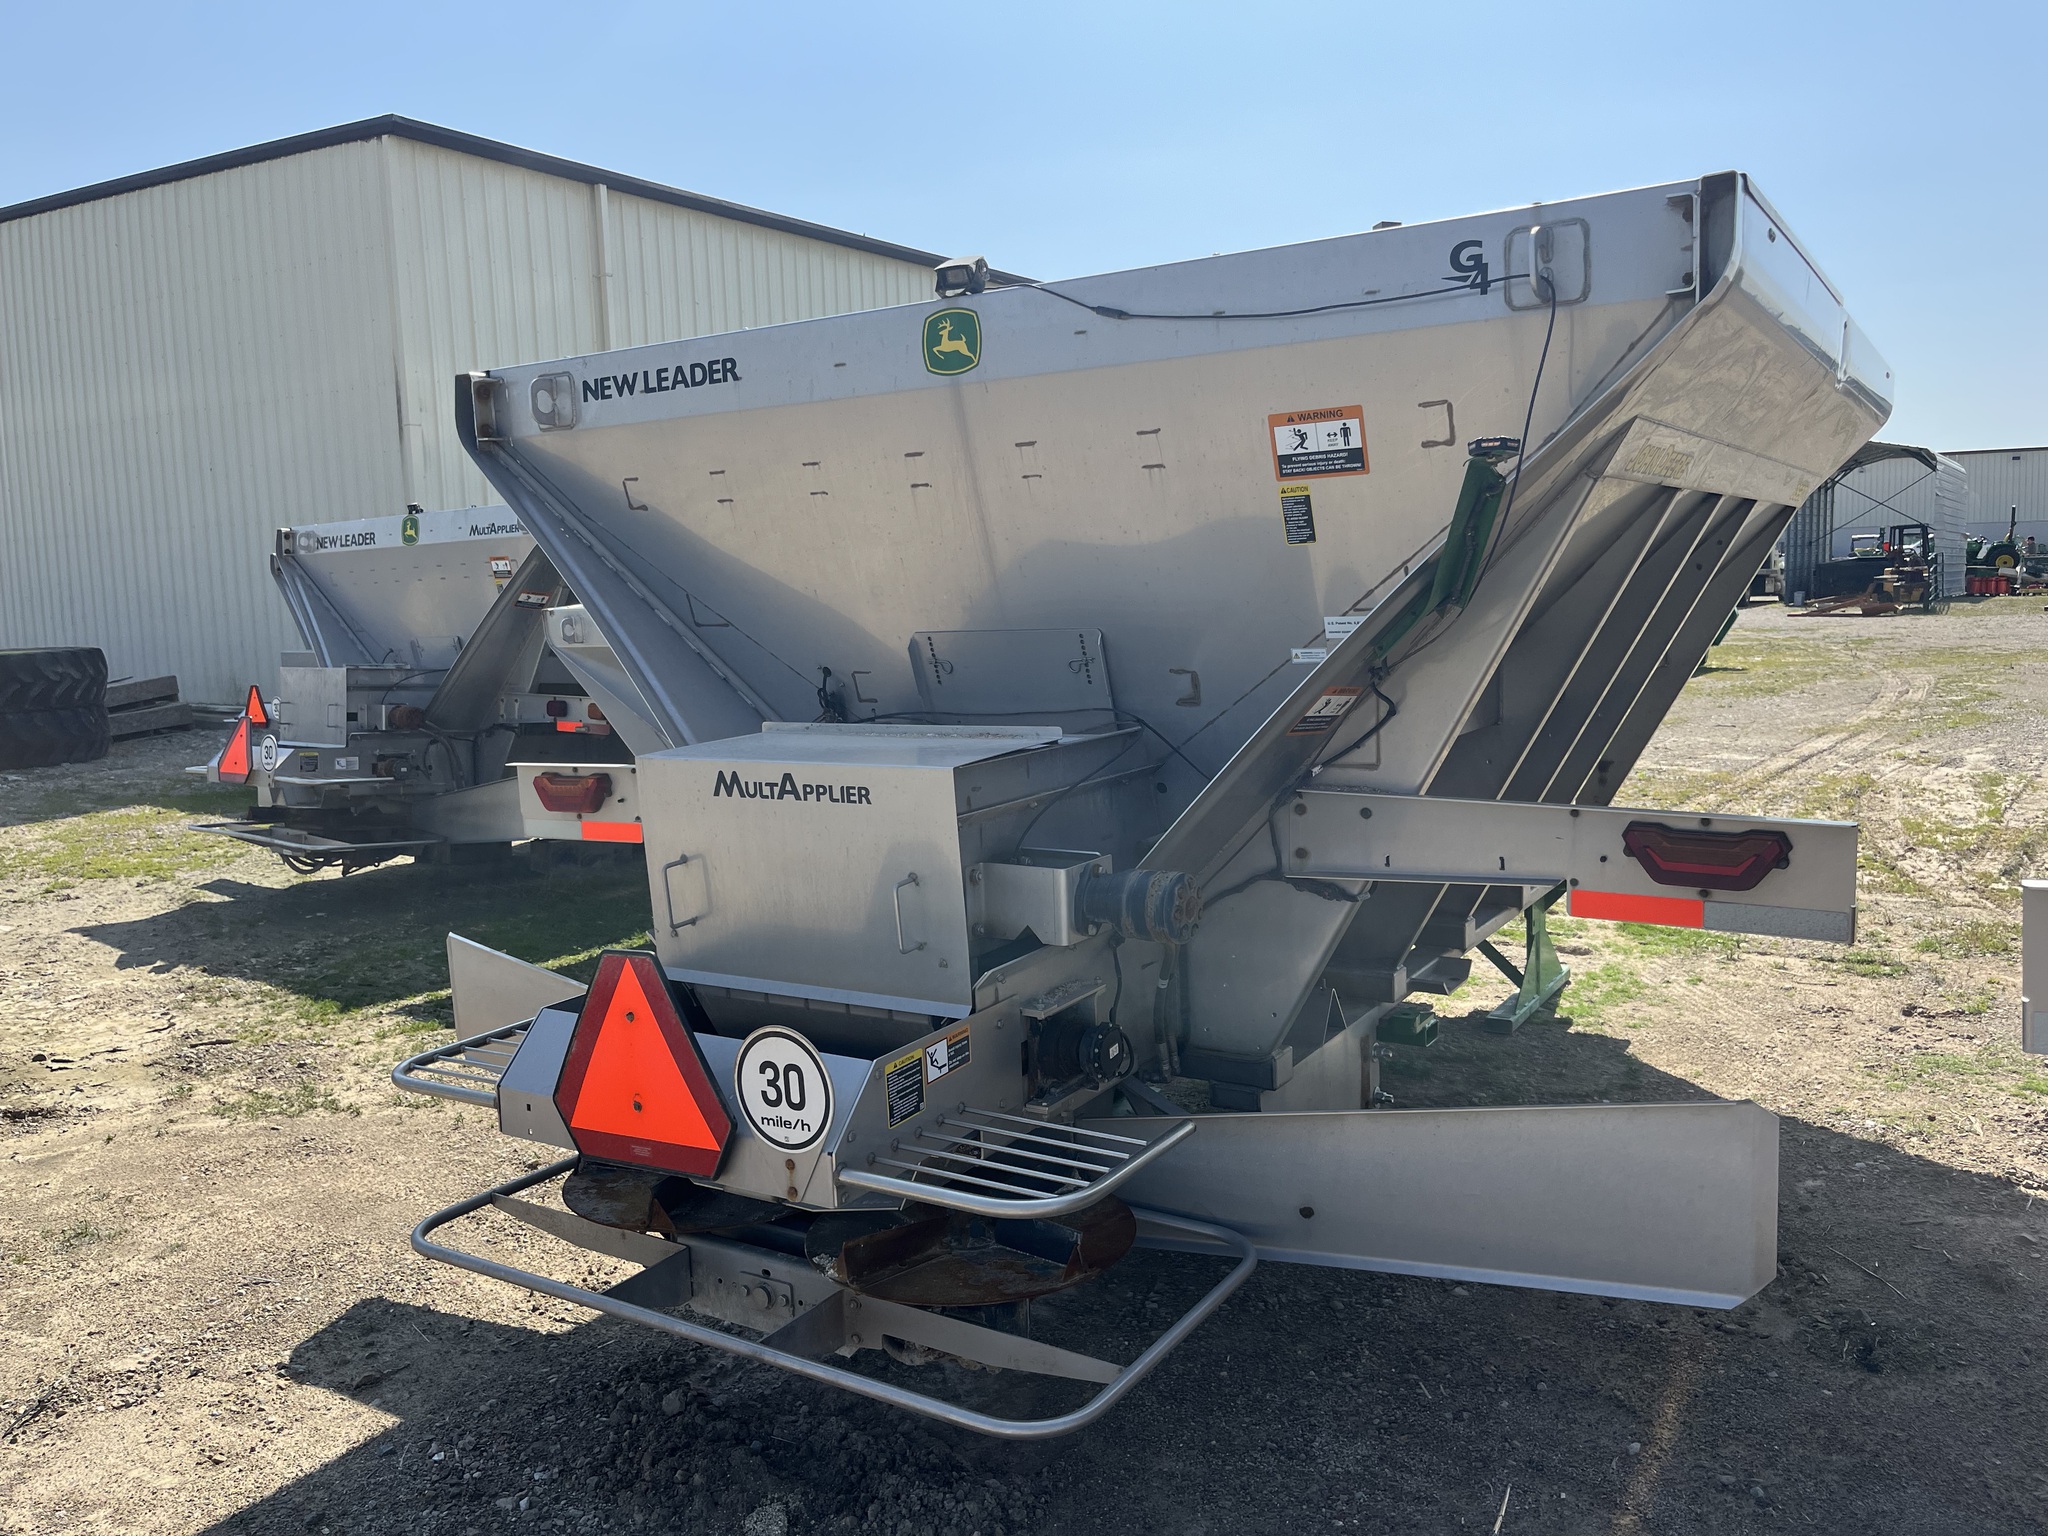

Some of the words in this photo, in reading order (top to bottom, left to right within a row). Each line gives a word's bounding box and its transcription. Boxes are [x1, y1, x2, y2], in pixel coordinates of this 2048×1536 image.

[582, 372, 638, 402] NEW
[642, 357, 740, 394] LEADER
[1297, 409, 1343, 421] WARNING
[316, 535, 338, 550] NEW
[340, 532, 376, 548] LEADER
[264, 746, 273, 760] 30
[898, 1054, 914, 1066] CAUTION
[759, 1060, 806, 1111] 30
[760, 1116, 811, 1132] mile/h
